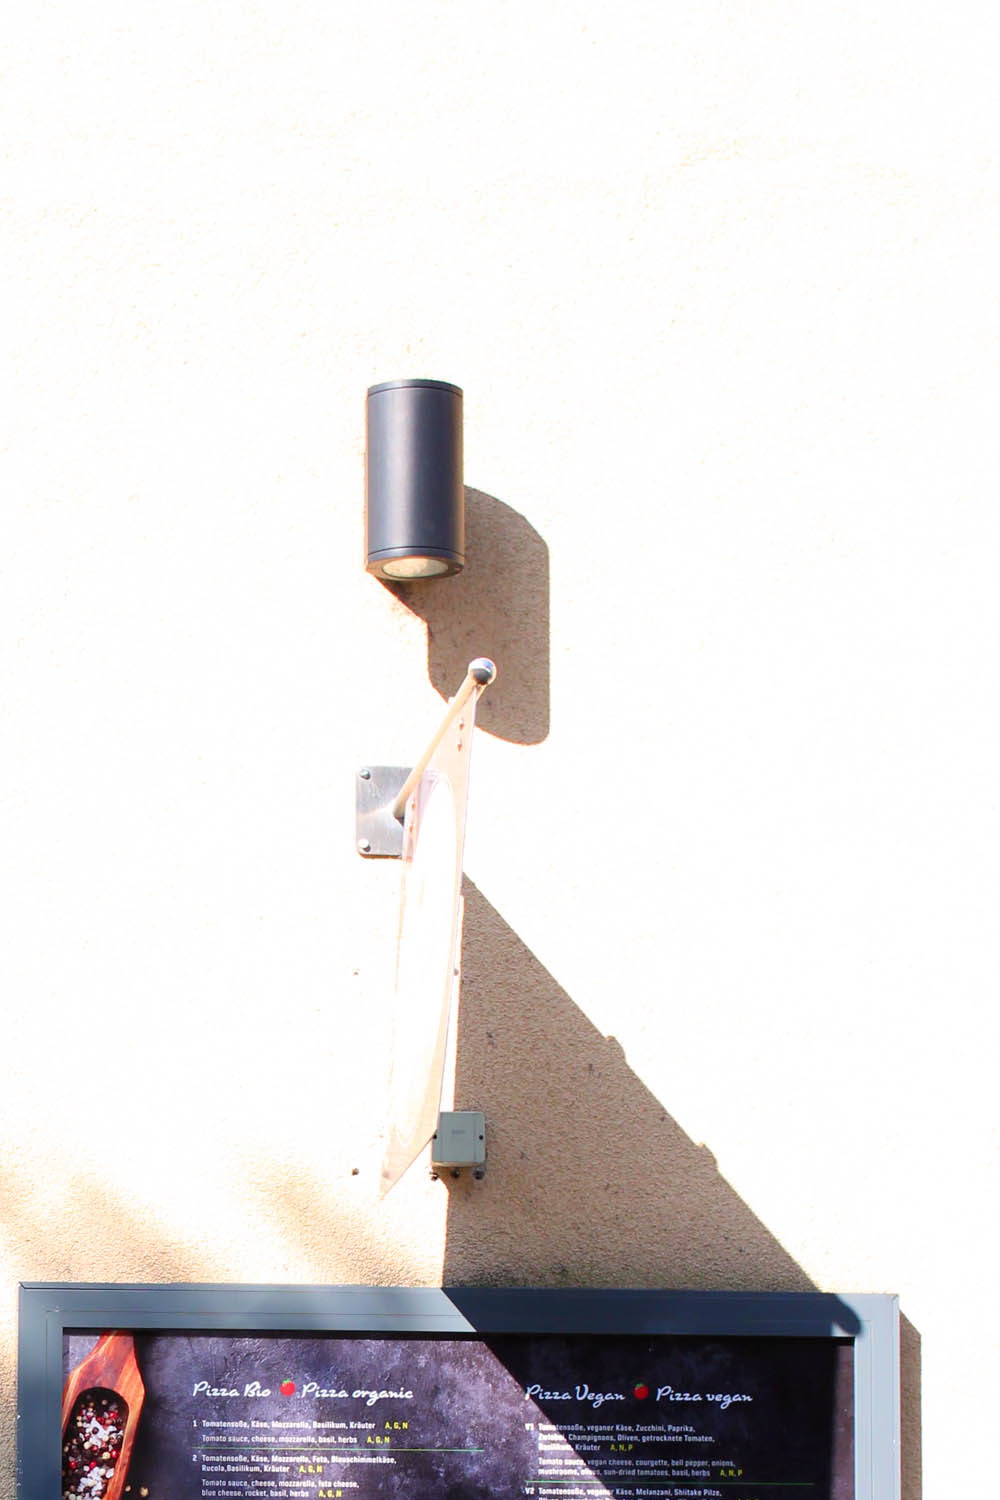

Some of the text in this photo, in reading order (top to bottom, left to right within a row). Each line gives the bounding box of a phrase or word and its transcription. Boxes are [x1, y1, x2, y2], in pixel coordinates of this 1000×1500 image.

[193, 1381, 414, 1406] Pizza Bio Pizza organic
[525, 1384, 753, 1409] Pizza Vegan Pizza vegan
